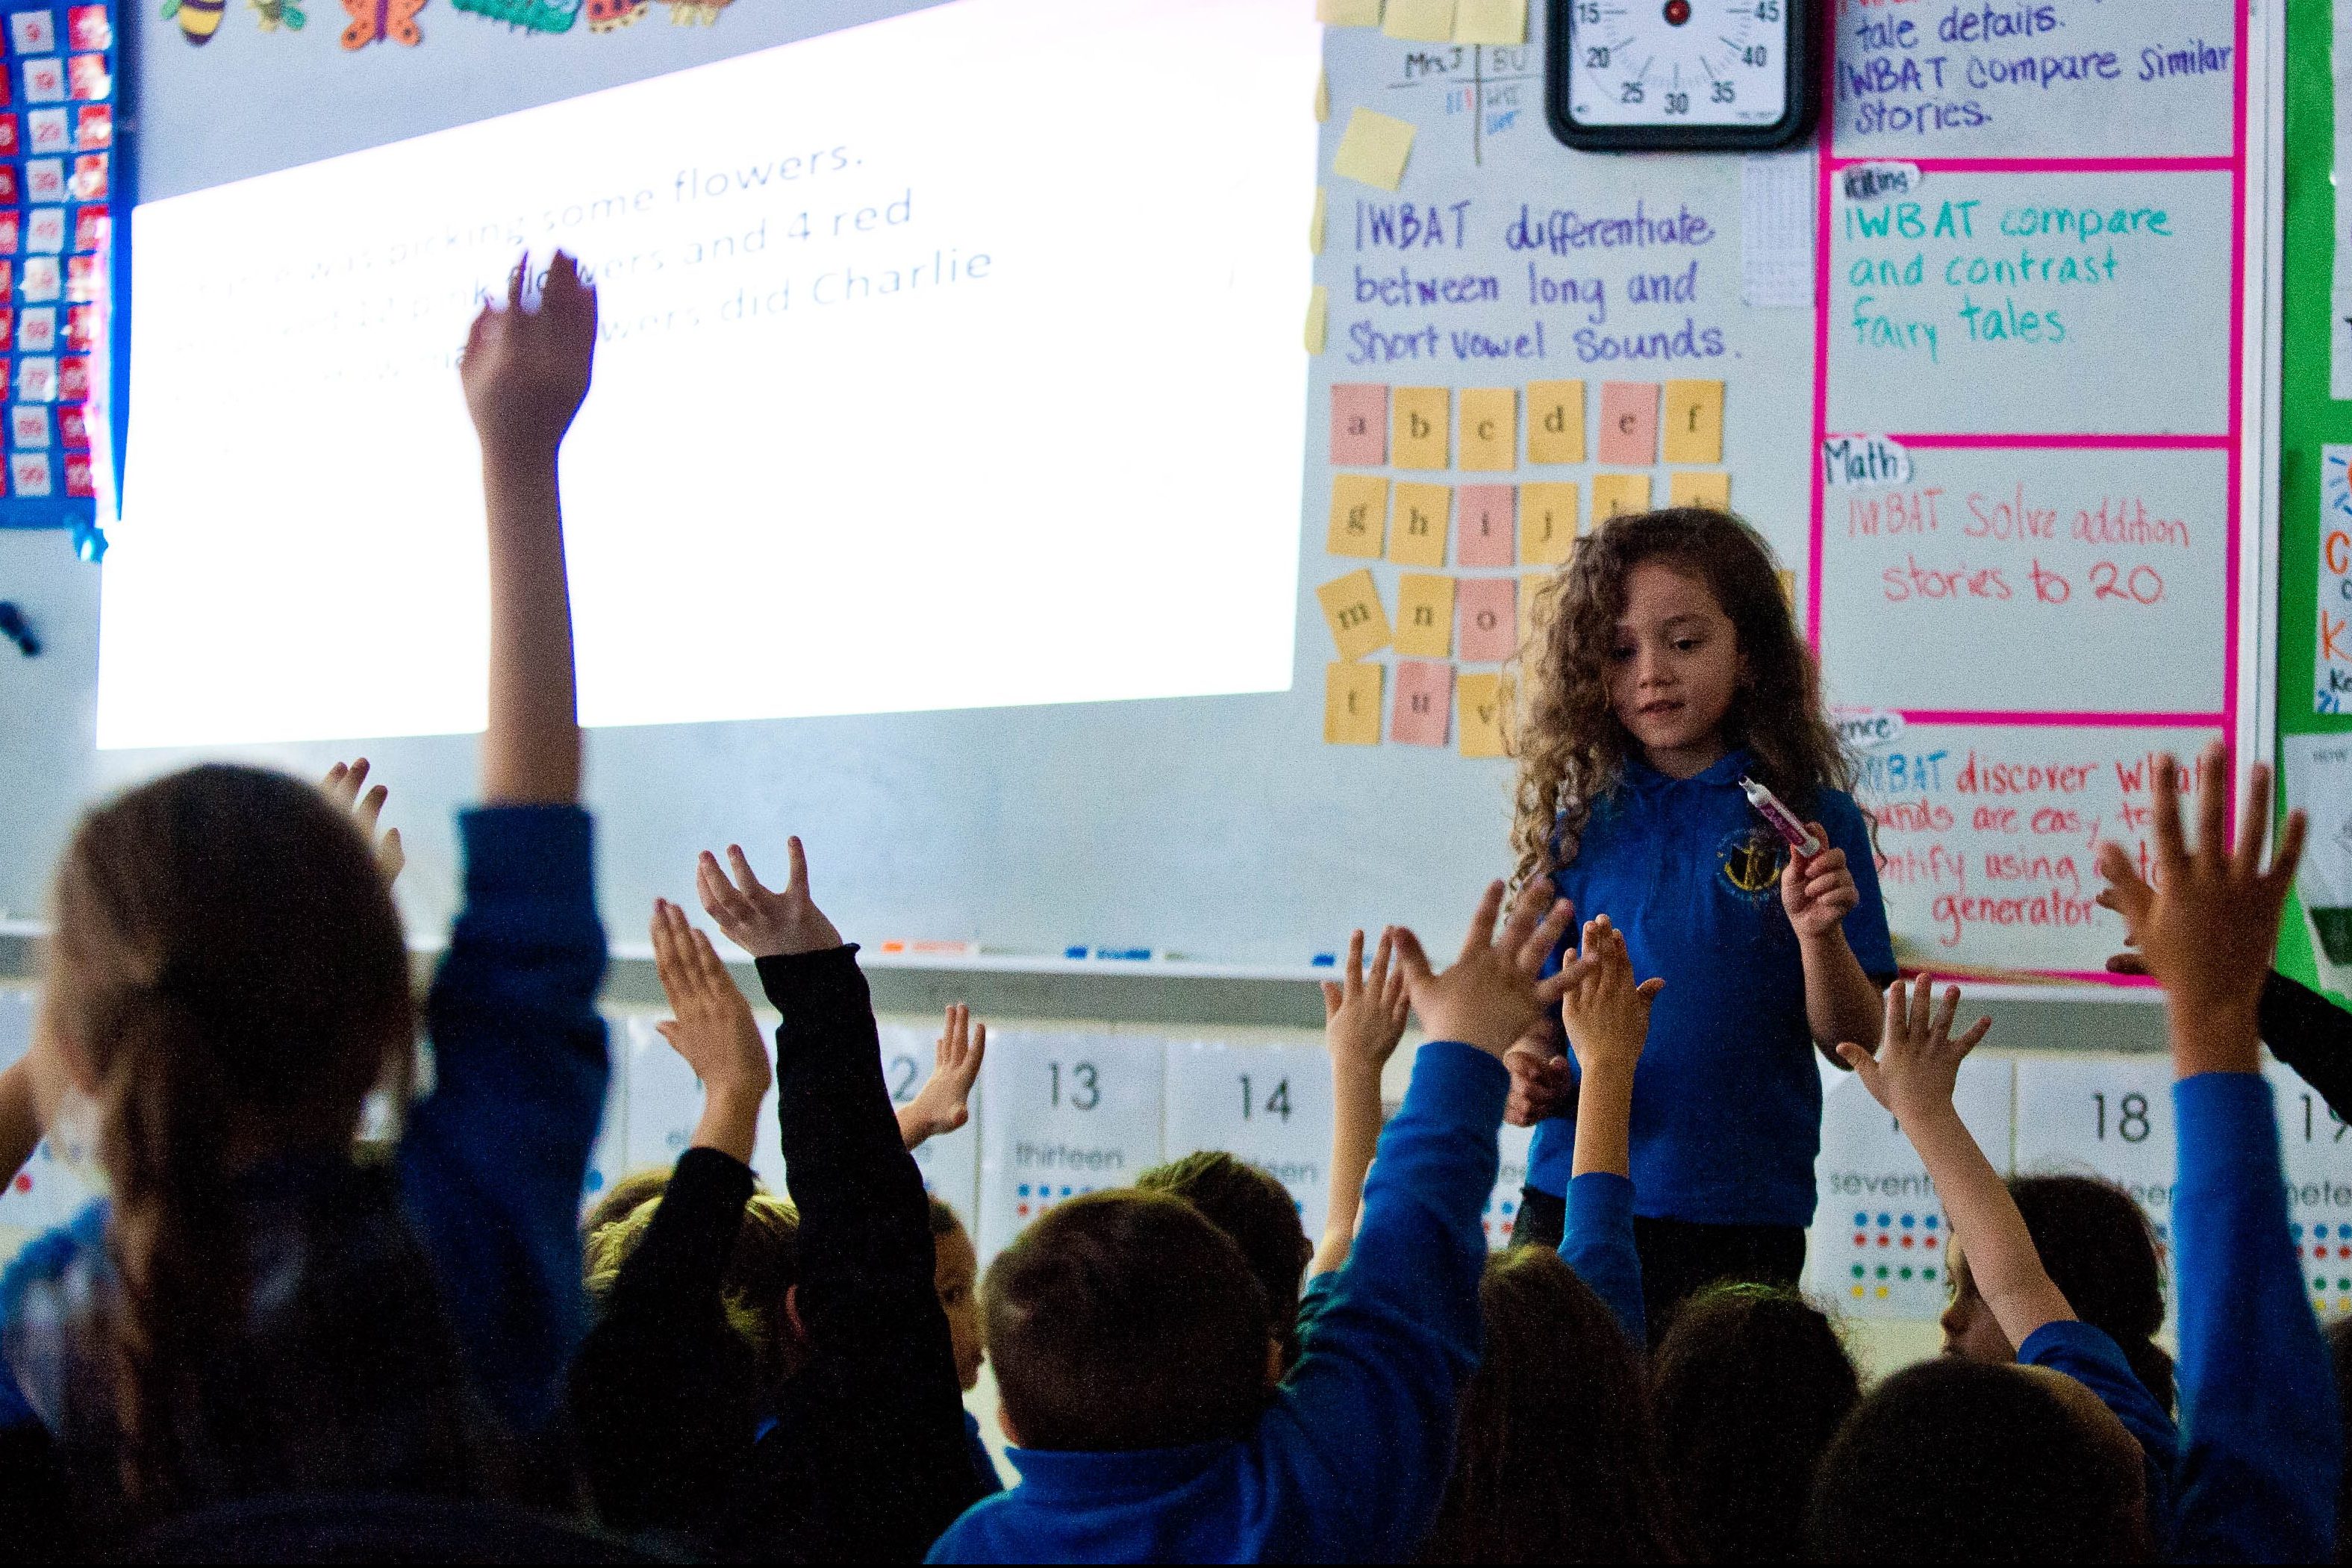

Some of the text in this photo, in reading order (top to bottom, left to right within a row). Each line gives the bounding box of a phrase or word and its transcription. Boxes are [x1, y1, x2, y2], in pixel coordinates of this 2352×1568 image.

[1577, 2, 1601, 24] 15
[1755, 0, 1779, 22] 45
[1855, 13, 1918, 51] tale
[1585, 46, 1609, 68] 20
[1741, 44, 1767, 67] 40
[1620, 80, 1644, 104] 25
[1664, 91, 1689, 115] 30
[1711, 80, 1736, 104] 35
[543, 188, 655, 232] some
[675, 145, 863, 202] flowers.
[688, 218, 766, 265] and
[787, 211, 811, 243] 4
[833, 188, 912, 237] red
[1505, 199, 1715, 256] differentiate
[2000, 202, 2173, 242] compare
[720, 279, 790, 322] did
[813, 249, 993, 306] Charlie
[1850, 248, 2120, 287] and contrast
[1353, 260, 1698, 325] between long and
[1451, 319, 1546, 360] vowel
[1853, 296, 1938, 363] fairy
[1348, 403, 1702, 440] a b c d e f
[1825, 439, 1899, 483] Math
[1348, 504, 1366, 536] g
[1409, 507, 1429, 536] h
[2071, 495, 2191, 548] addition
[2031, 557, 2070, 604] to
[1338, 602, 1496, 631] m n o
[1411, 690, 1429, 714] u
[1956, 748, 2098, 796] discover
[1985, 845, 2082, 896] using
[1049, 1061, 1101, 1111] 13
[1239, 1072, 1292, 1122] 14
[2091, 1092, 2150, 1143] 18
[1016, 1141, 1124, 1172] thirteen
